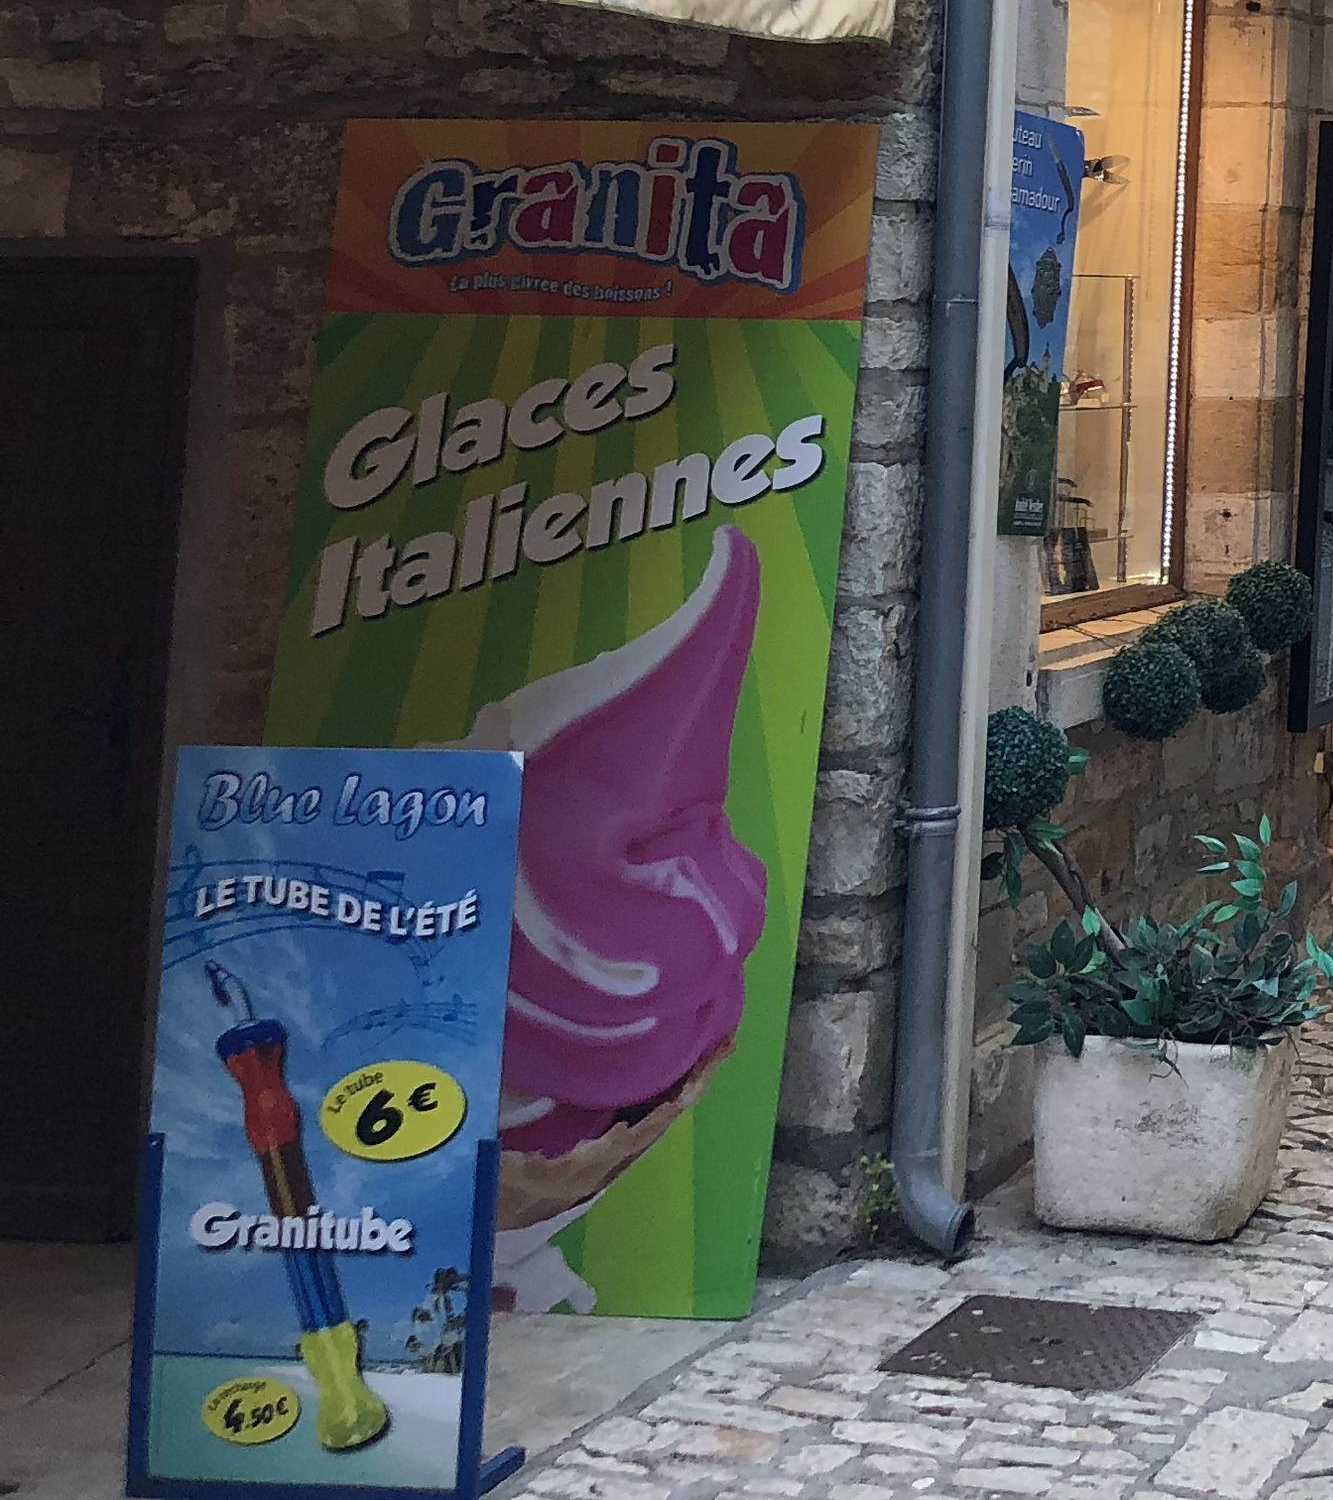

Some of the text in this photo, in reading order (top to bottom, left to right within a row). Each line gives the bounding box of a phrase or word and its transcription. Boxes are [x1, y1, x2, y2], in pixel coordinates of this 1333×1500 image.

[1013, 125, 1042, 149] uteau
[1013, 154, 1033, 177] erin
[391, 137, 802, 293] Granita
[1012, 187, 1060, 212] amadour
[473, 271, 506, 291] plus
[563, 281, 590, 299] des
[323, 344, 675, 509] Glaces
[310, 414, 824, 637] Italiennes
[200, 771, 489, 840] Blue Lagon
[195, 874, 480, 938] LE TUBE DE L'ÉTÉ
[327, 1070, 384, 1114] Le tube
[189, 1202, 416, 1254] Granitube
